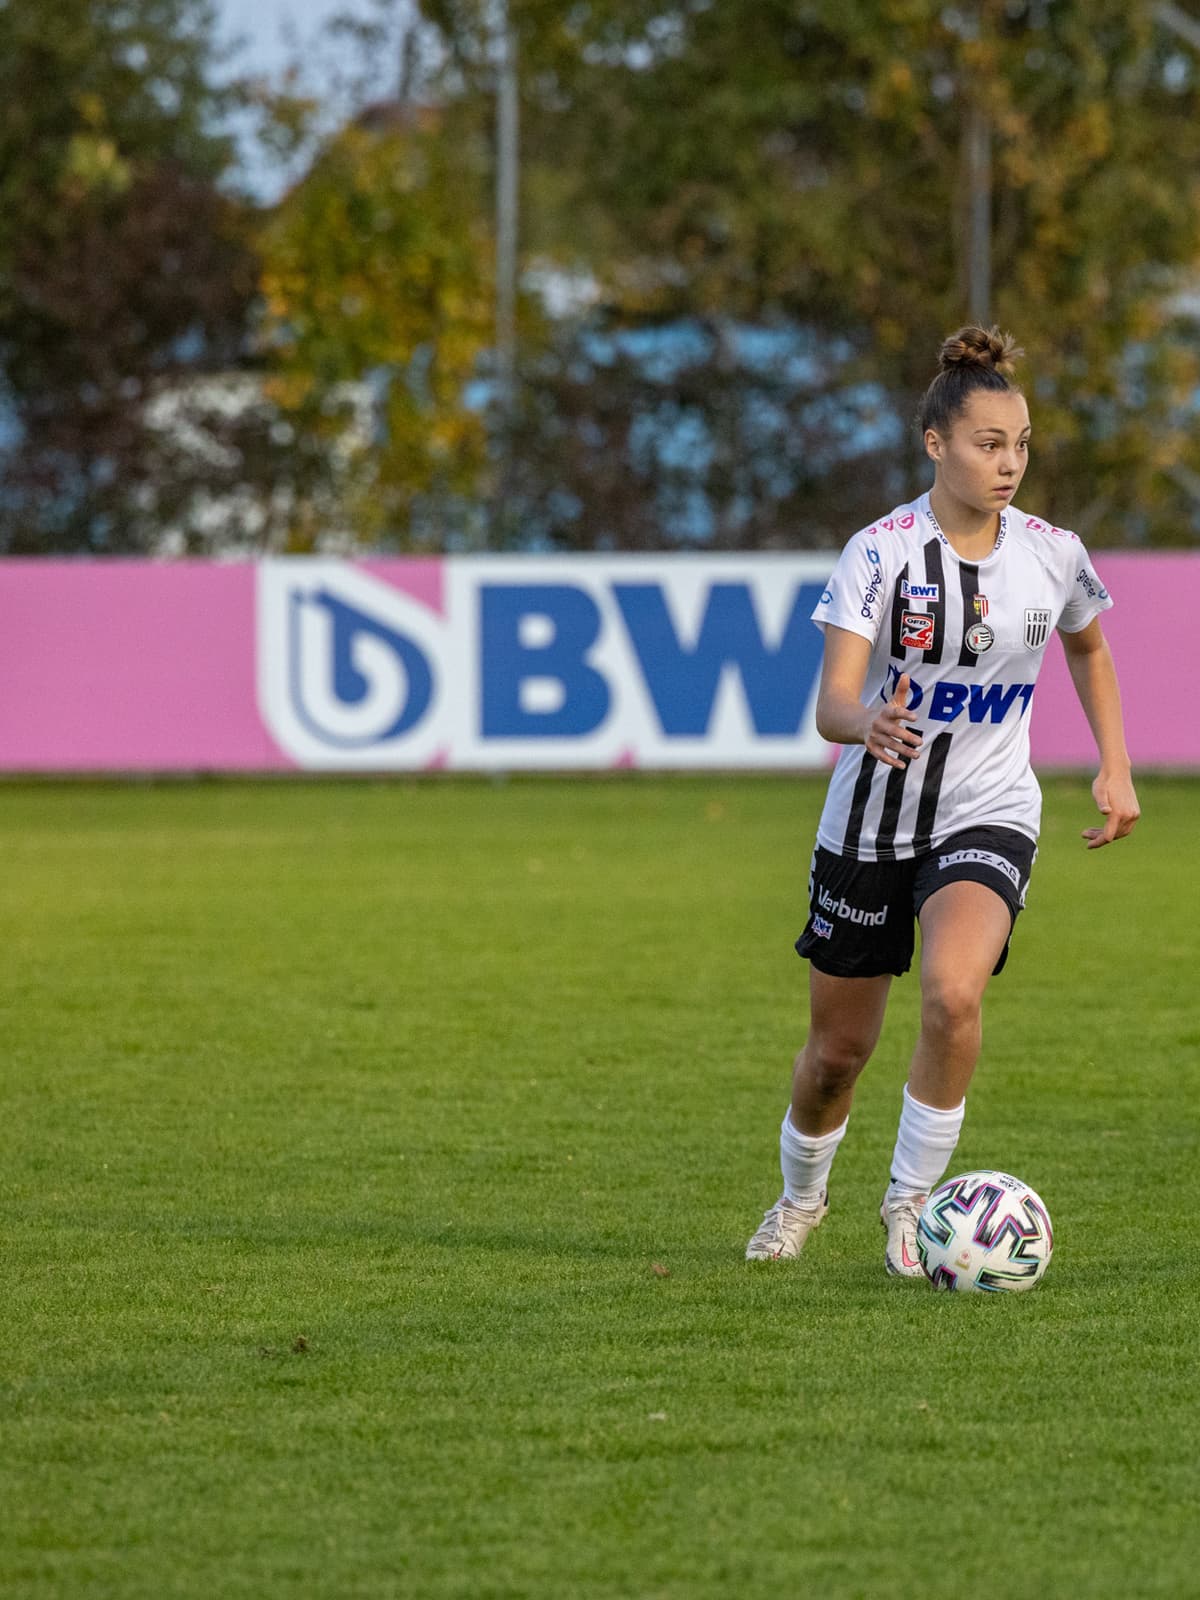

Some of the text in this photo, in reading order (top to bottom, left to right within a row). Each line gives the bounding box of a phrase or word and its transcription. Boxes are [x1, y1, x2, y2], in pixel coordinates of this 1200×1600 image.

[861, 568, 882, 620] greiner
[910, 585, 937, 597] BWT
[1027, 612, 1048, 623] LASK
[477, 583, 827, 739] BW
[996, 860, 1018, 882] AG
[818, 884, 888, 927] Verbund
